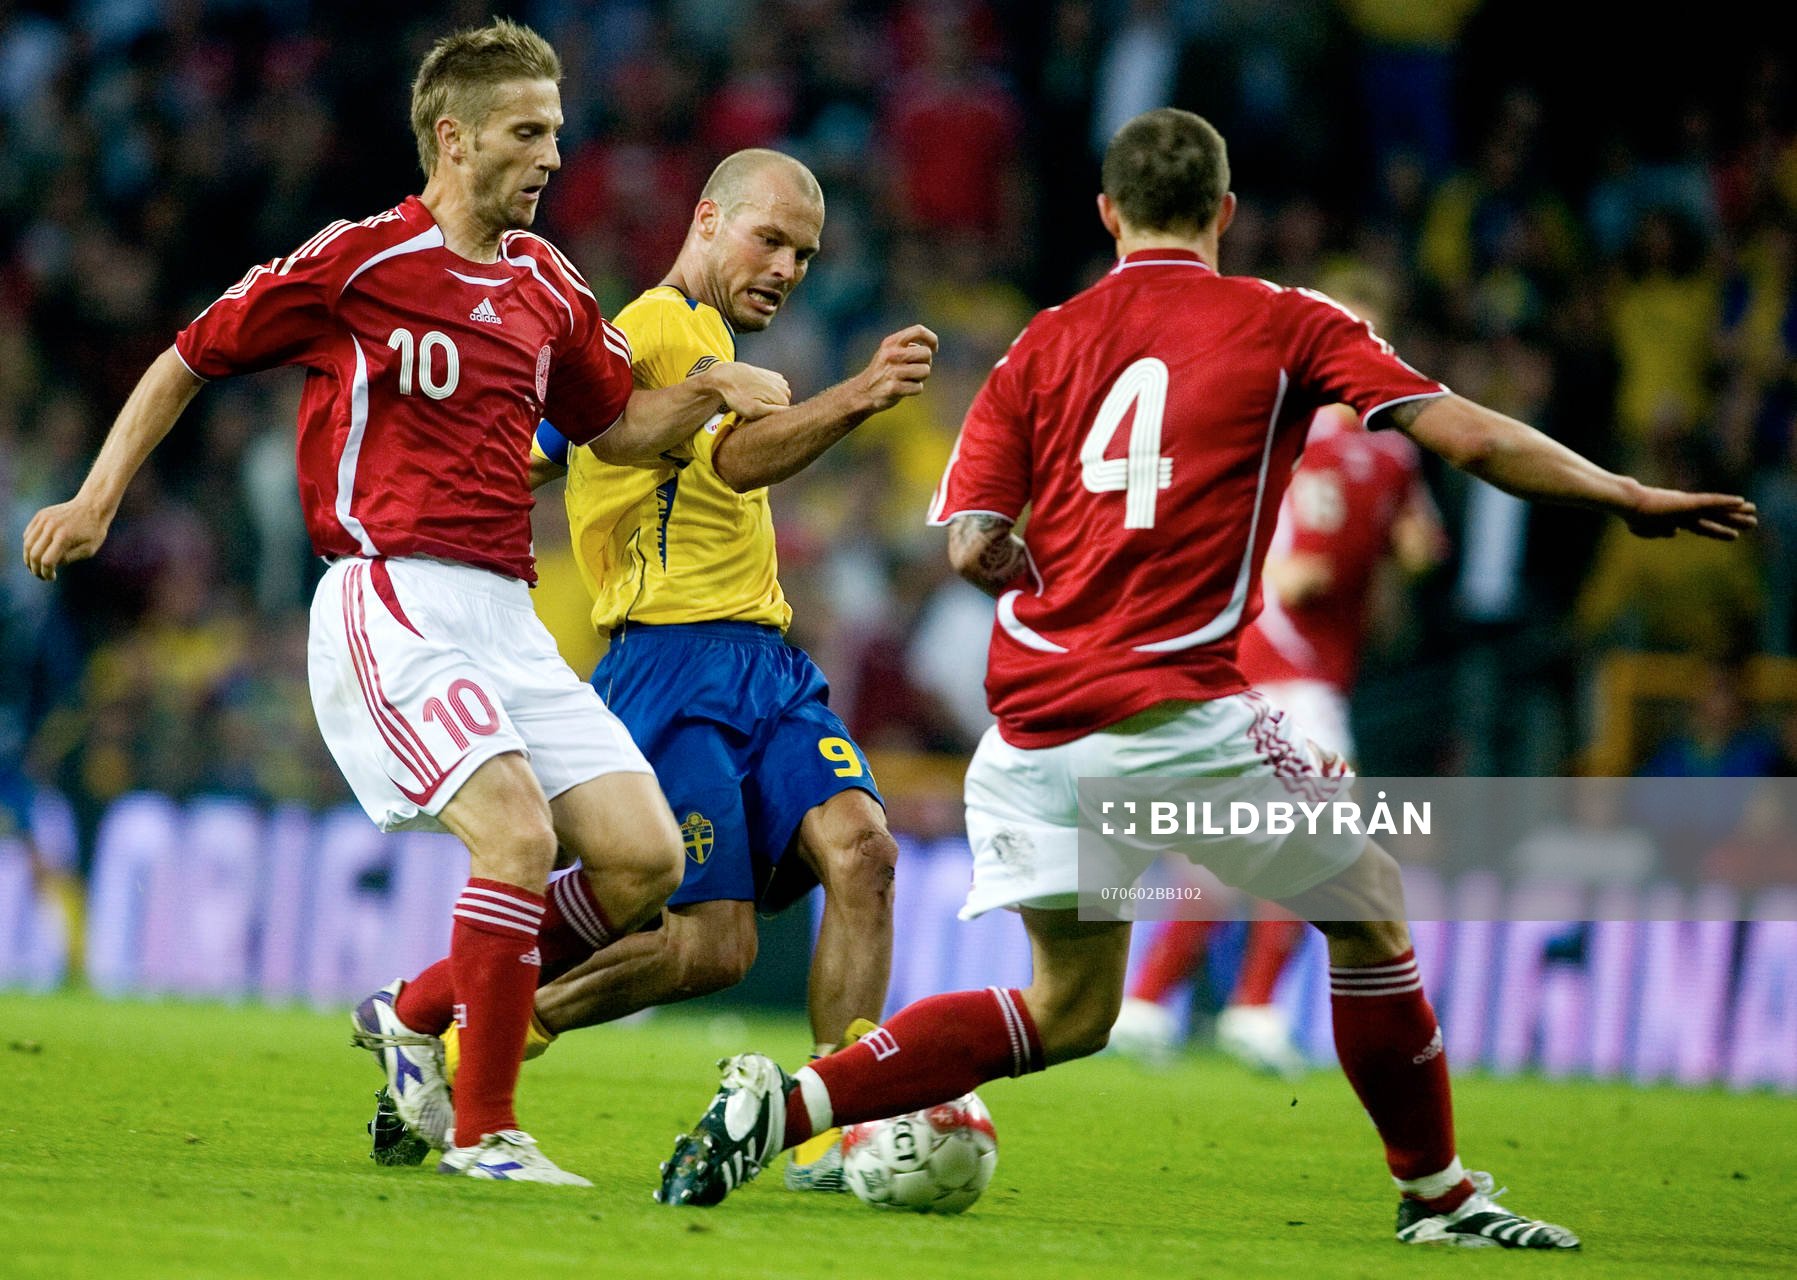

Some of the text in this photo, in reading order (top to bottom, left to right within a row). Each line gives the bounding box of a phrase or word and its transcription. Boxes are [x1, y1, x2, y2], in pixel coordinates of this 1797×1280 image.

[469, 313, 502, 325] adidas
[387, 327, 460, 400] 10
[1079, 357, 1174, 529] 4
[423, 678, 501, 751] 10
[818, 737, 863, 778] 9
